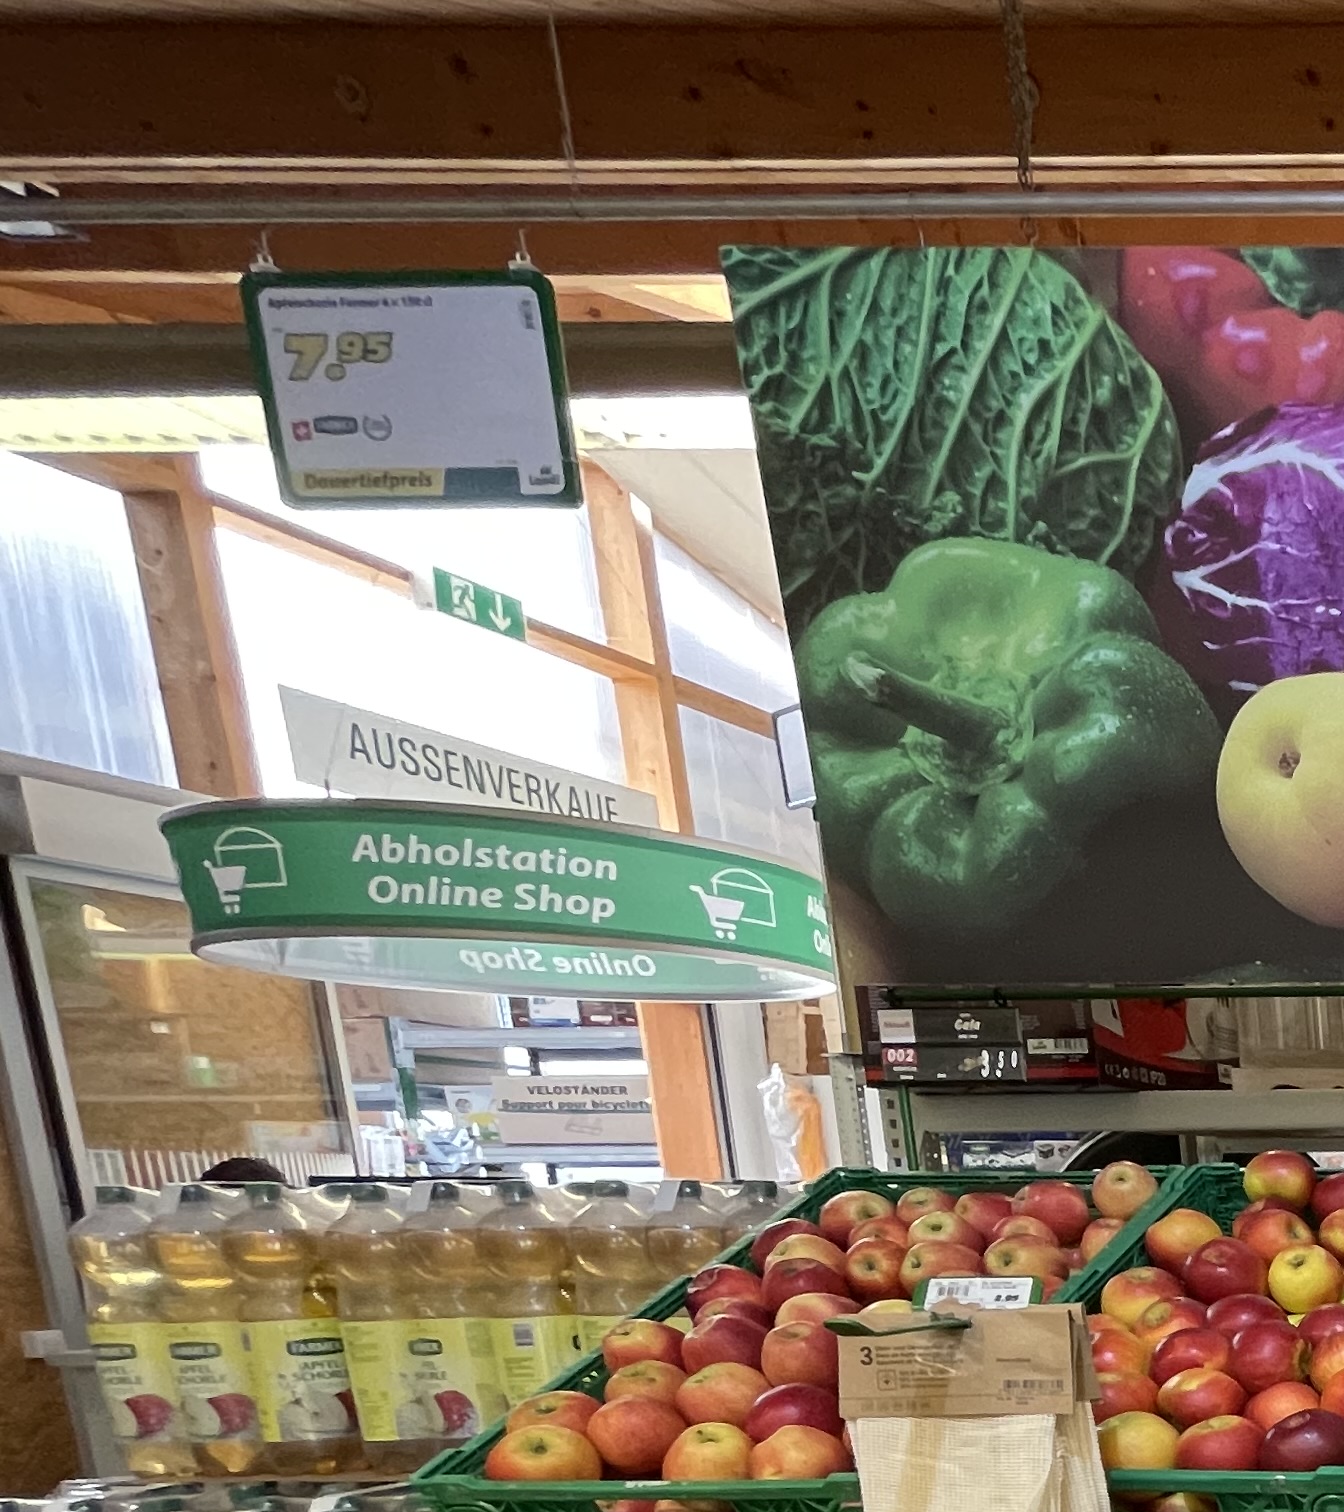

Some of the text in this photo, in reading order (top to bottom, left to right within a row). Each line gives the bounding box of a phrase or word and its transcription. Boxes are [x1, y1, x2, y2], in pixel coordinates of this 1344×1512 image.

[283, 331, 394, 382] 7.95
[350, 721, 618, 823] AUSSENVERKAUF
[352, 834, 618, 881] Abholstation
[367, 875, 616, 924] Online Shop
[886, 1048, 916, 1063] 002
[859, 1346, 873, 1366] 3
